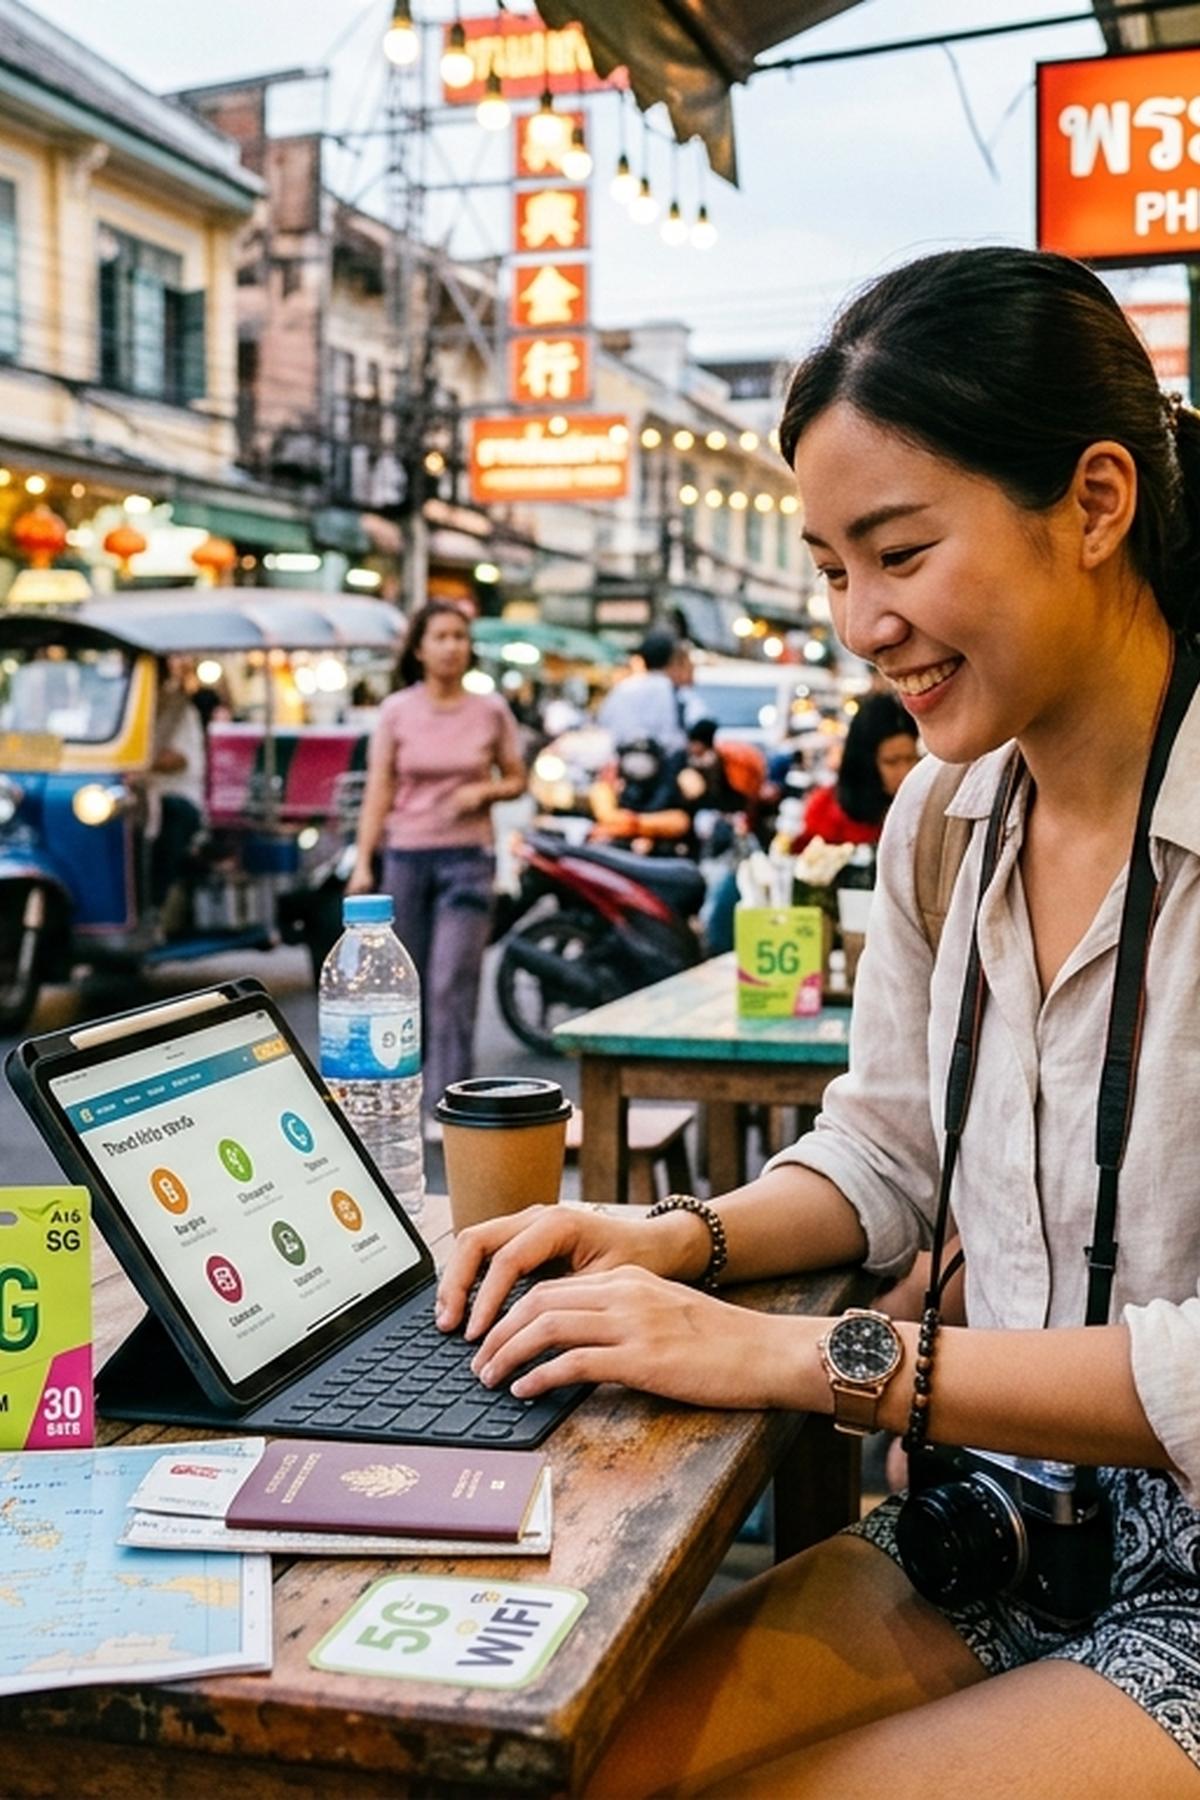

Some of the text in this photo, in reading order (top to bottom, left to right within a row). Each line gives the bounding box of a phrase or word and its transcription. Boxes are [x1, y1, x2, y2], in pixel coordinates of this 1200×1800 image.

[757, 941, 800, 975] 5G
[43, 1386, 83, 1421] 30
[355, 1601, 450, 1654] 5G
[456, 1597, 553, 1666] WIFI
